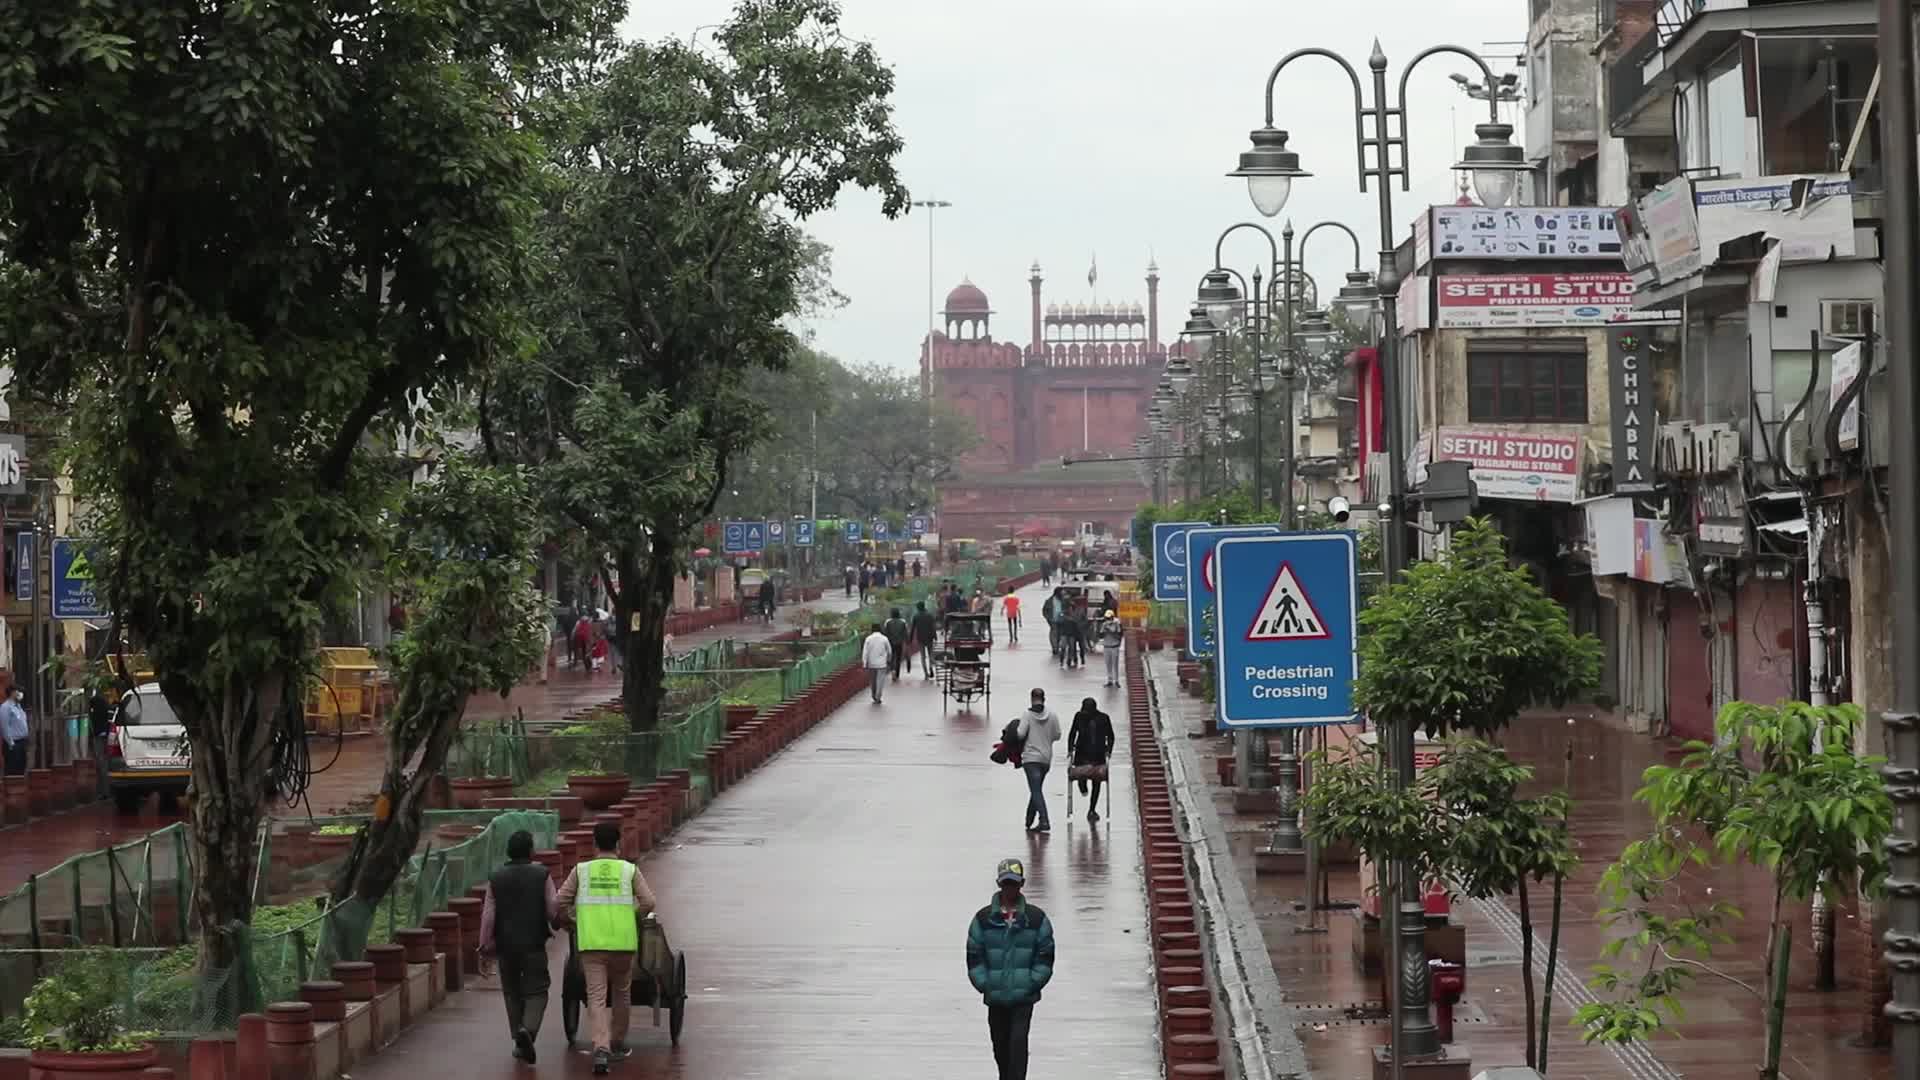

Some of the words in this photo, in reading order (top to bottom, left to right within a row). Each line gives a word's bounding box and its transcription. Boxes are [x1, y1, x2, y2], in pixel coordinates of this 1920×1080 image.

[1446, 283, 1542, 296] SETHI
[1553, 282, 1637, 295] STUD
[1489, 297, 1588, 306] PHOTOGRAPHIC
[1590, 296, 1631, 305] STORE
[1623, 355, 1643, 481] CHHABRA
[1442, 438, 1498, 456] SETHI
[1503, 441, 1574, 460] STUDIO
[1470, 458, 1529, 470] TOGRAPHIC
[1531, 461, 1563, 472] STORE
[1245, 665, 1334, 680] Pedestrian
[1252, 684, 1328, 699] Crossing
